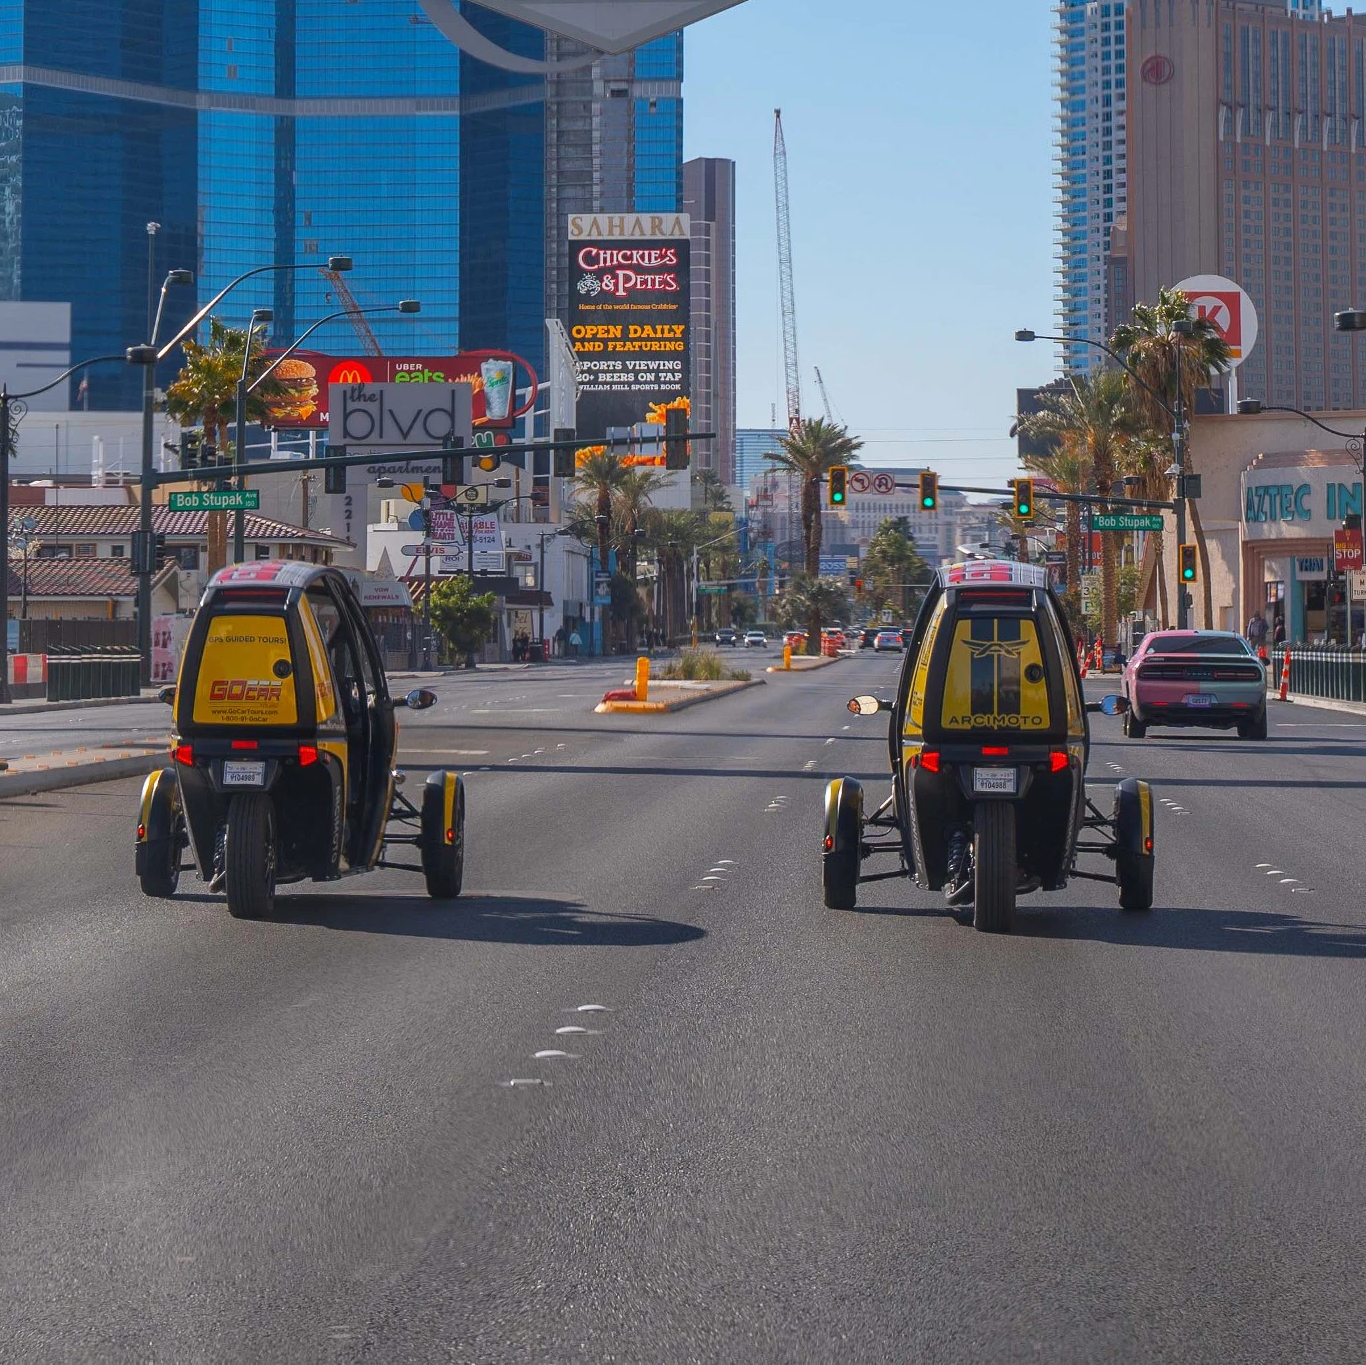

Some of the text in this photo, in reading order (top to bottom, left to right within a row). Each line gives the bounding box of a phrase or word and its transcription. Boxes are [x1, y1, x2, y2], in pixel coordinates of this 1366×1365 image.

[570, 215, 686, 237] SAHARA
[578, 246, 677, 270] CHICKIE'S
[602, 274, 616, 292] &
[571, 324, 685, 338] OPEN DAILY
[573, 341, 684, 352] AND FEATURING
[395, 363, 422, 371] UBER
[626, 360, 682, 370] VIEWING
[395, 369, 444, 383] eats
[576, 372, 683, 382] 20+ BEERS ON TAP
[349, 383, 379, 403] the
[343, 389, 455, 441] blvd
[366, 460, 443, 481] apartmen
[177, 493, 199, 507] Bob
[202, 492, 244, 508] Stupak
[1246, 483, 1311, 523] AZTEC
[1098, 517, 1117, 527] Bob
[1118, 517, 1151, 528] Stupak
[1335, 548, 1361, 559] STOP
[258, 636, 287, 644] TOURS!
[211, 708, 278, 716] www.GoCarTours.com
[948, 714, 1043, 727] ARCIMOTO
